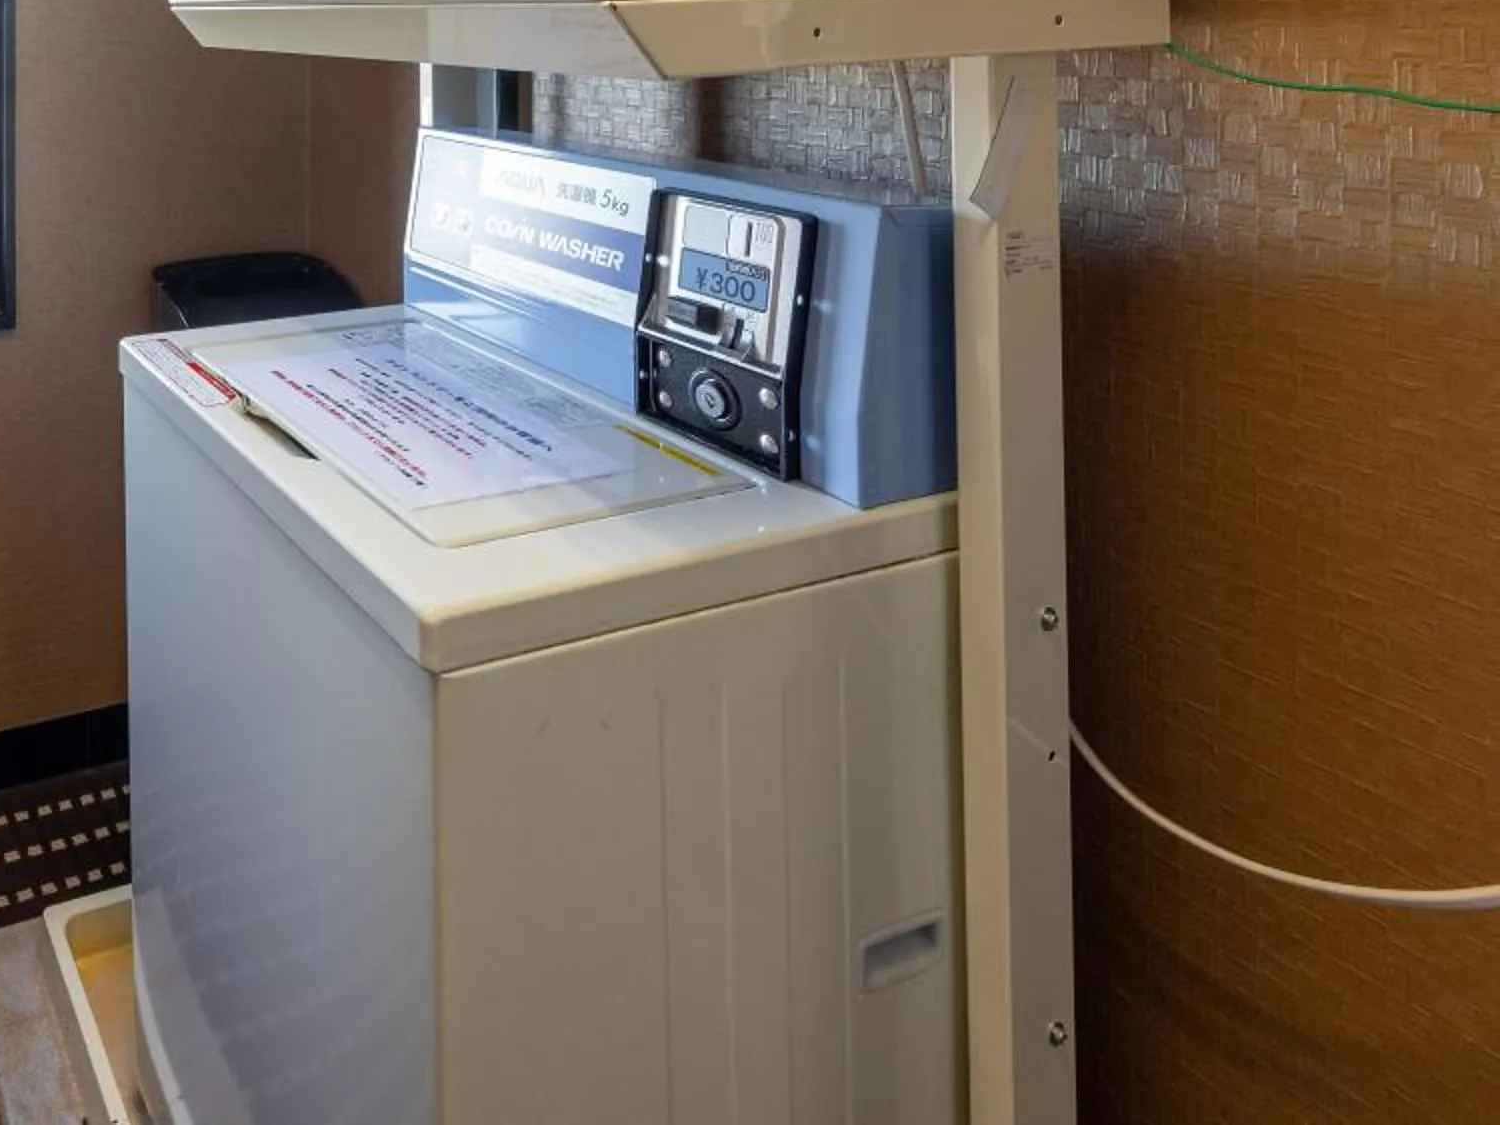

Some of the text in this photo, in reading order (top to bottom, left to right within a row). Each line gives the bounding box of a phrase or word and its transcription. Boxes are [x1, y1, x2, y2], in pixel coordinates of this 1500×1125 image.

[484, 216, 625, 272] COIN WASHER
[695, 266, 757, 303] ¥300
